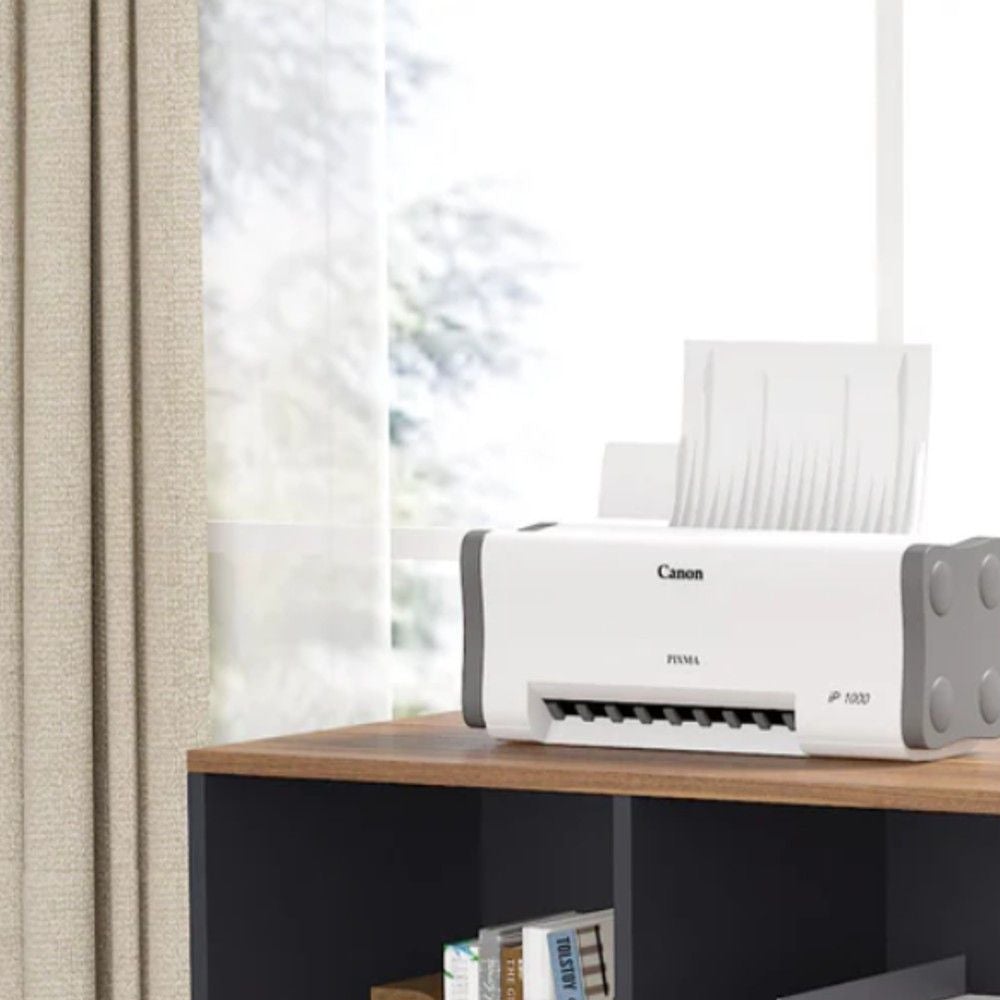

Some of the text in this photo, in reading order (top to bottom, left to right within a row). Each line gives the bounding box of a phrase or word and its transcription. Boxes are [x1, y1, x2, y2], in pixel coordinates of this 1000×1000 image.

[657, 564, 704, 580] Canon
[667, 655, 700, 666] PIXMA
[506, 959, 516, 981] THE
[556, 936, 577, 990] TOLSTOY
